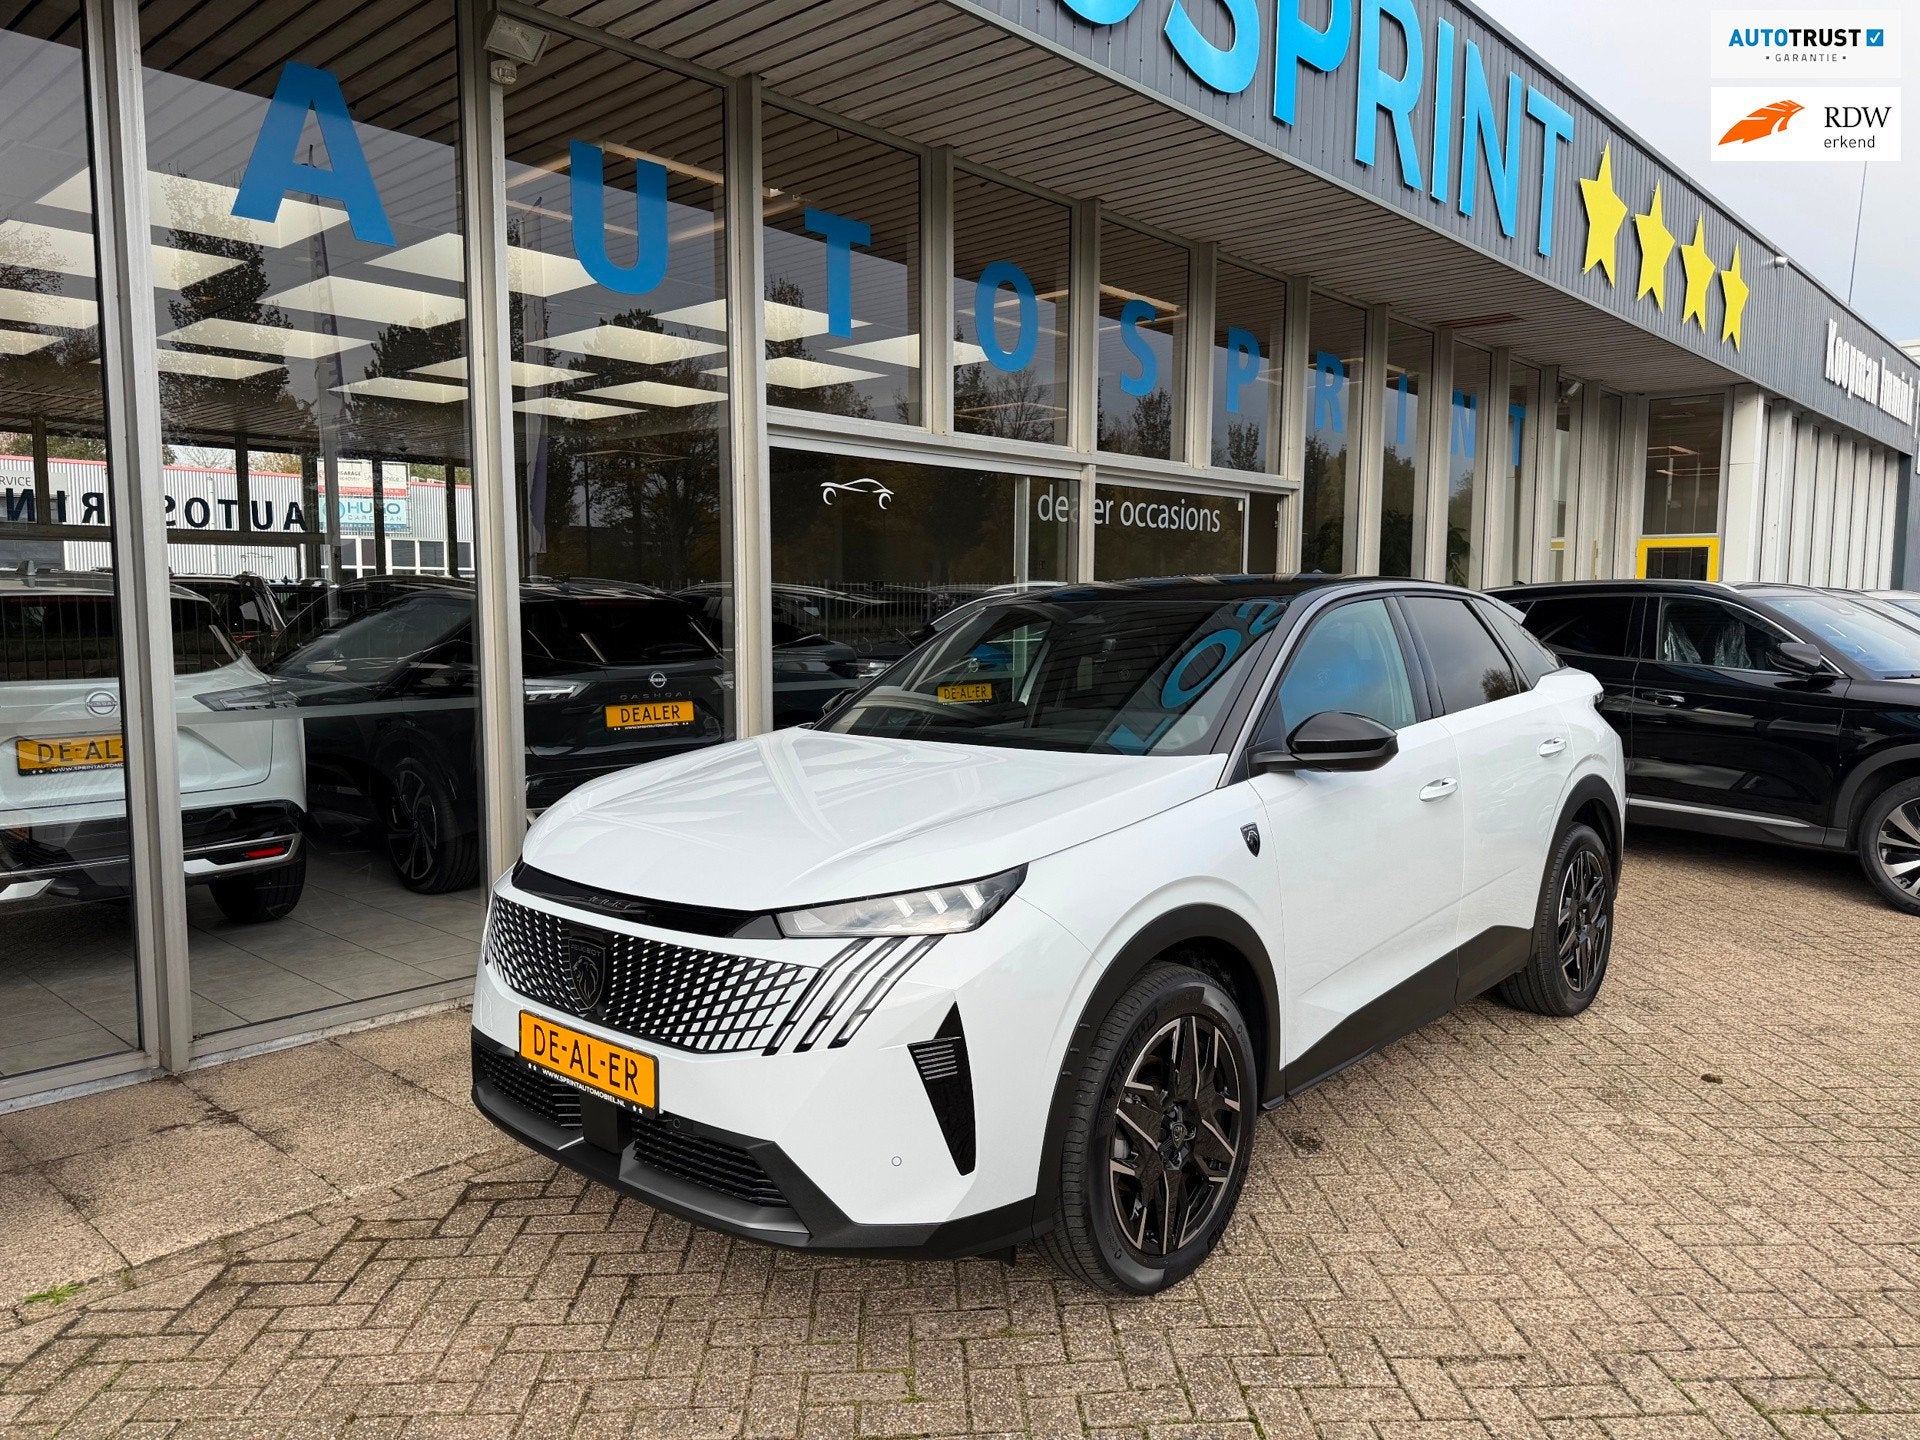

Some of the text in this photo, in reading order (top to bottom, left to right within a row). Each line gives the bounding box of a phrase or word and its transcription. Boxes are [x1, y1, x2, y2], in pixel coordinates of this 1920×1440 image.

[1825, 317, 1880, 406] Koopman
[347, 502, 401, 515] HUO
[1037, 483, 1221, 533] deaer occasions
[620, 705, 681, 723] DEALER
[532, 1023, 639, 1095] DE-AL-ER
